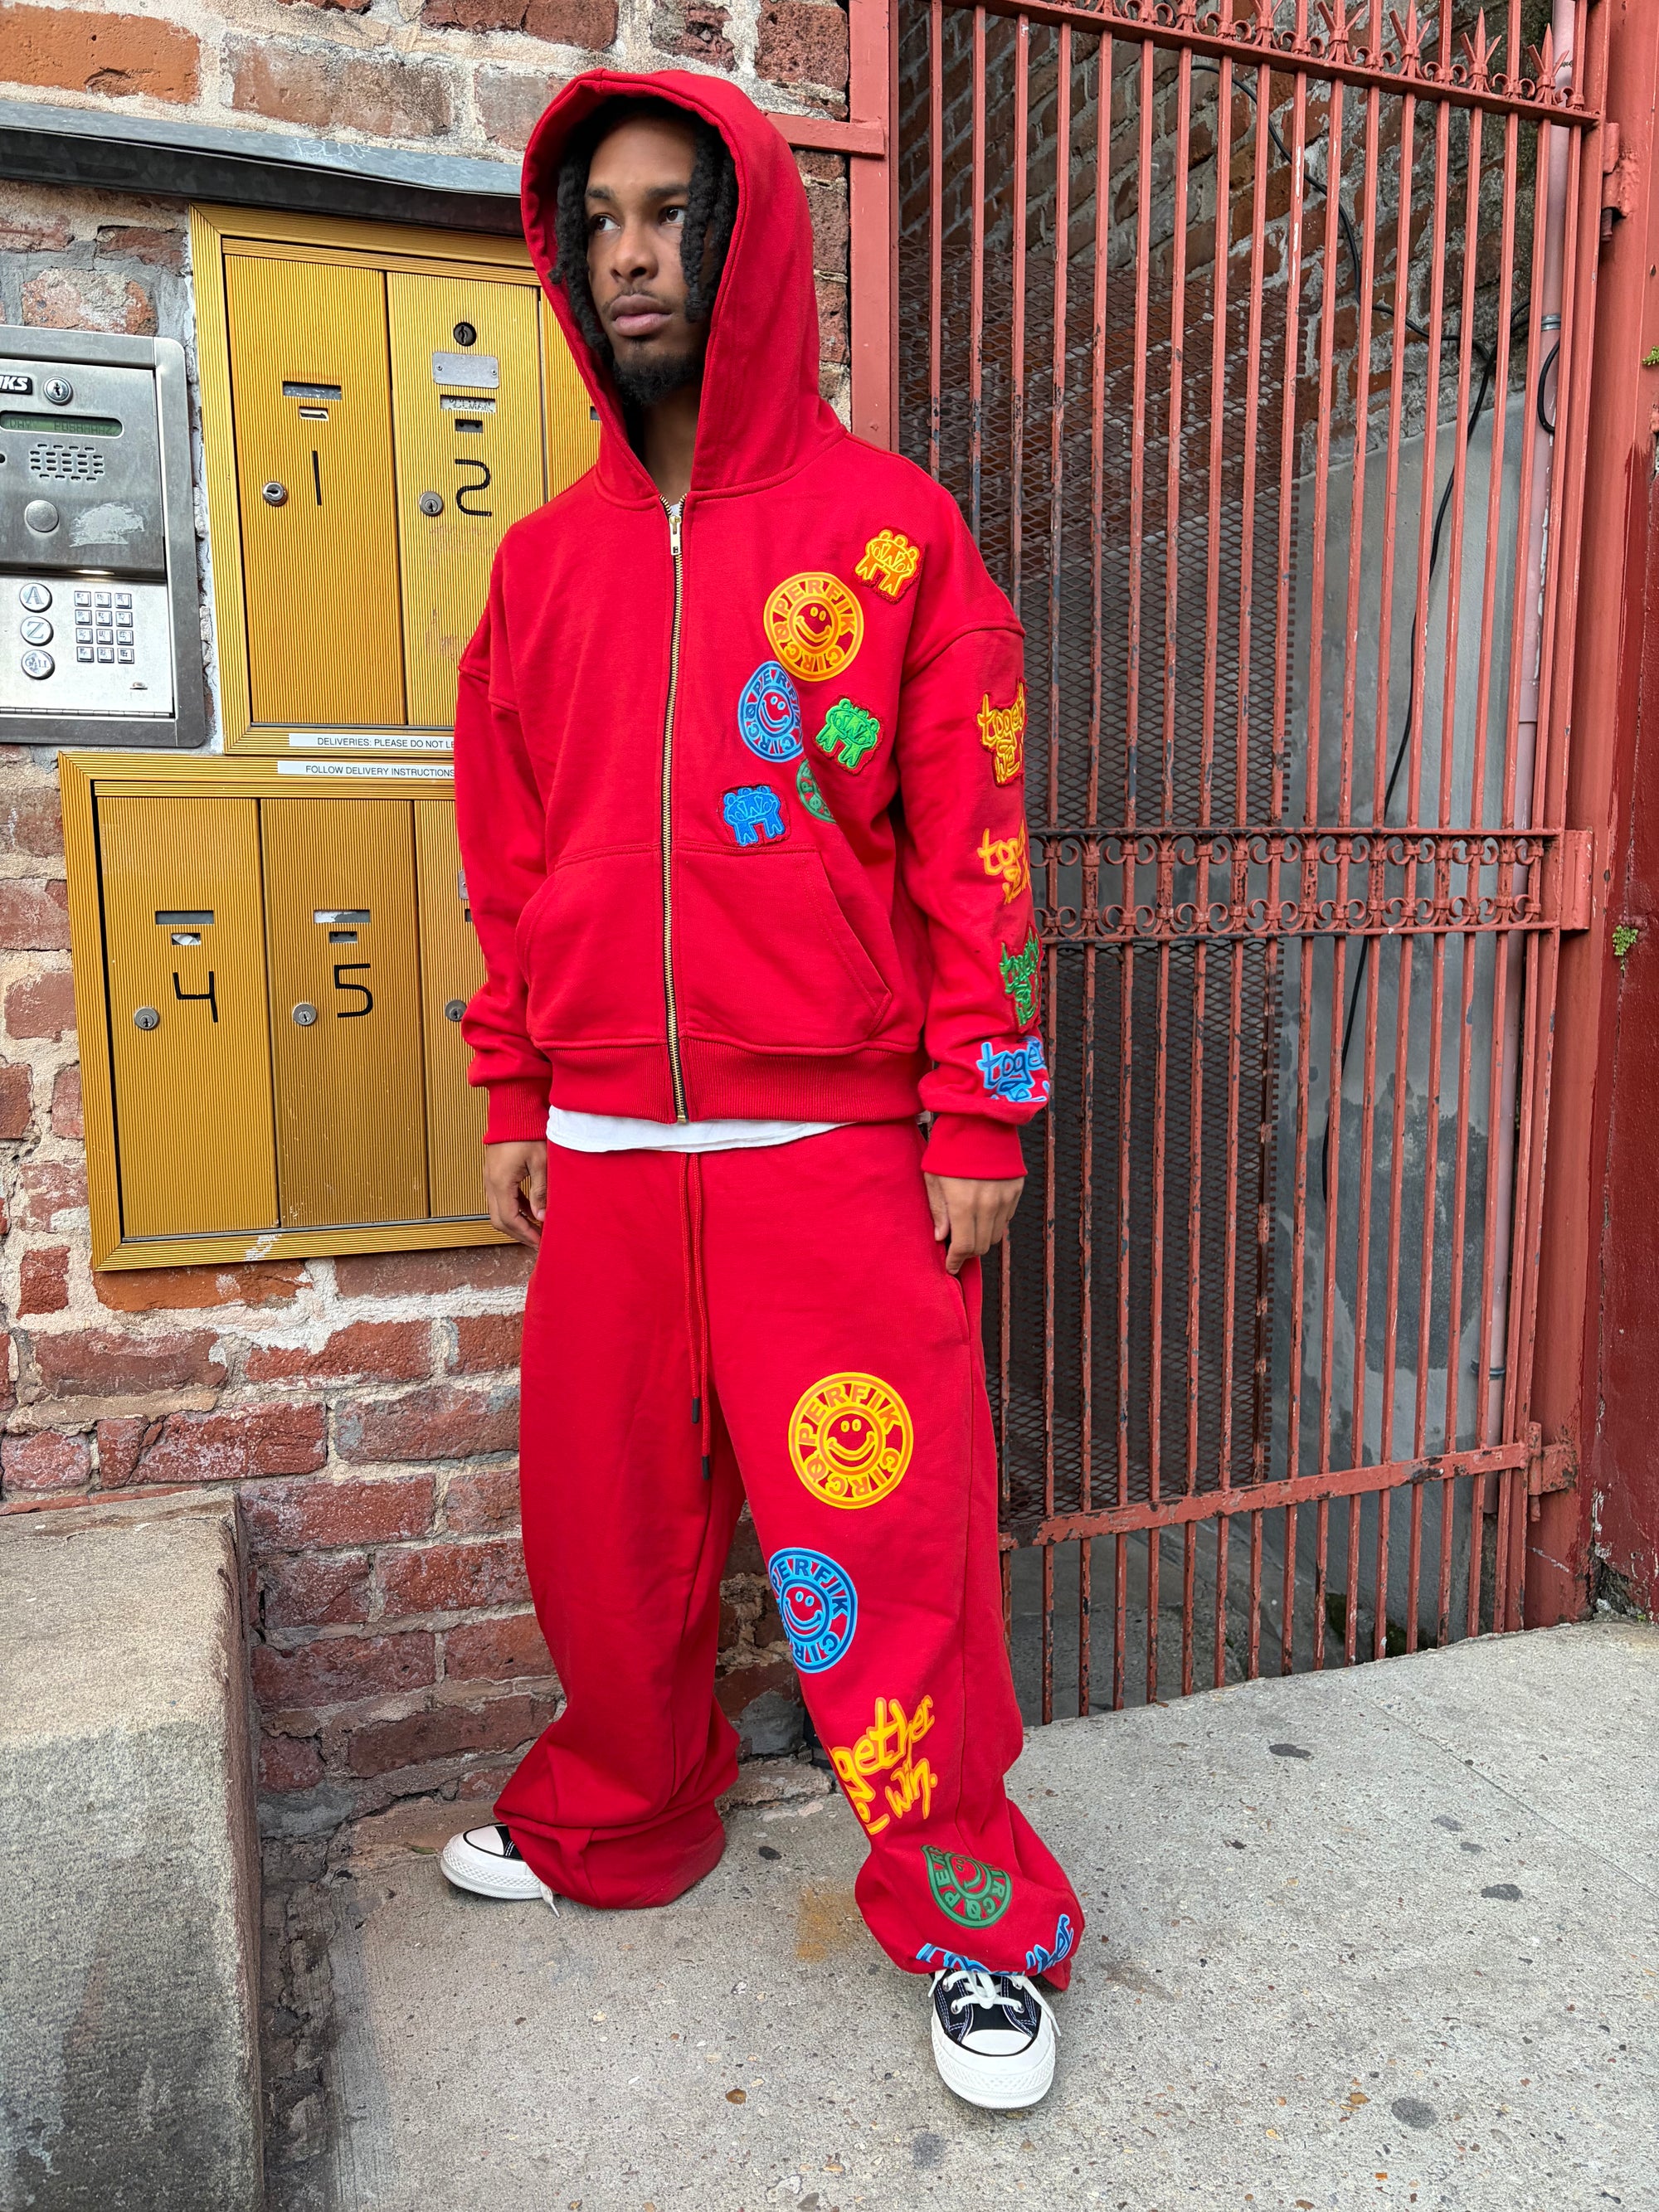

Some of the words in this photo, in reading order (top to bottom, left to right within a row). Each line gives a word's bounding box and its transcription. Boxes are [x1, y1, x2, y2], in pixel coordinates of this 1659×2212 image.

[454, 458, 492, 517] 2
[26, 586, 45, 605] A
[774, 579, 856, 634] PERFIK
[27, 621, 45, 639] Z
[317, 737, 372, 746] DELIVERIES:
[374, 738, 408, 747] PLEASE
[411, 739, 423, 748] DO
[426, 740, 445, 748] NOT
[305, 765, 343, 775] FOLLOW
[346, 766, 388, 775] DELIVERY
[392, 767, 455, 777] INSTRUCTIONS
[173, 970, 219, 1023] 4
[333, 963, 373, 1018] 5
[799, 1383, 901, 1444] PERFIK
